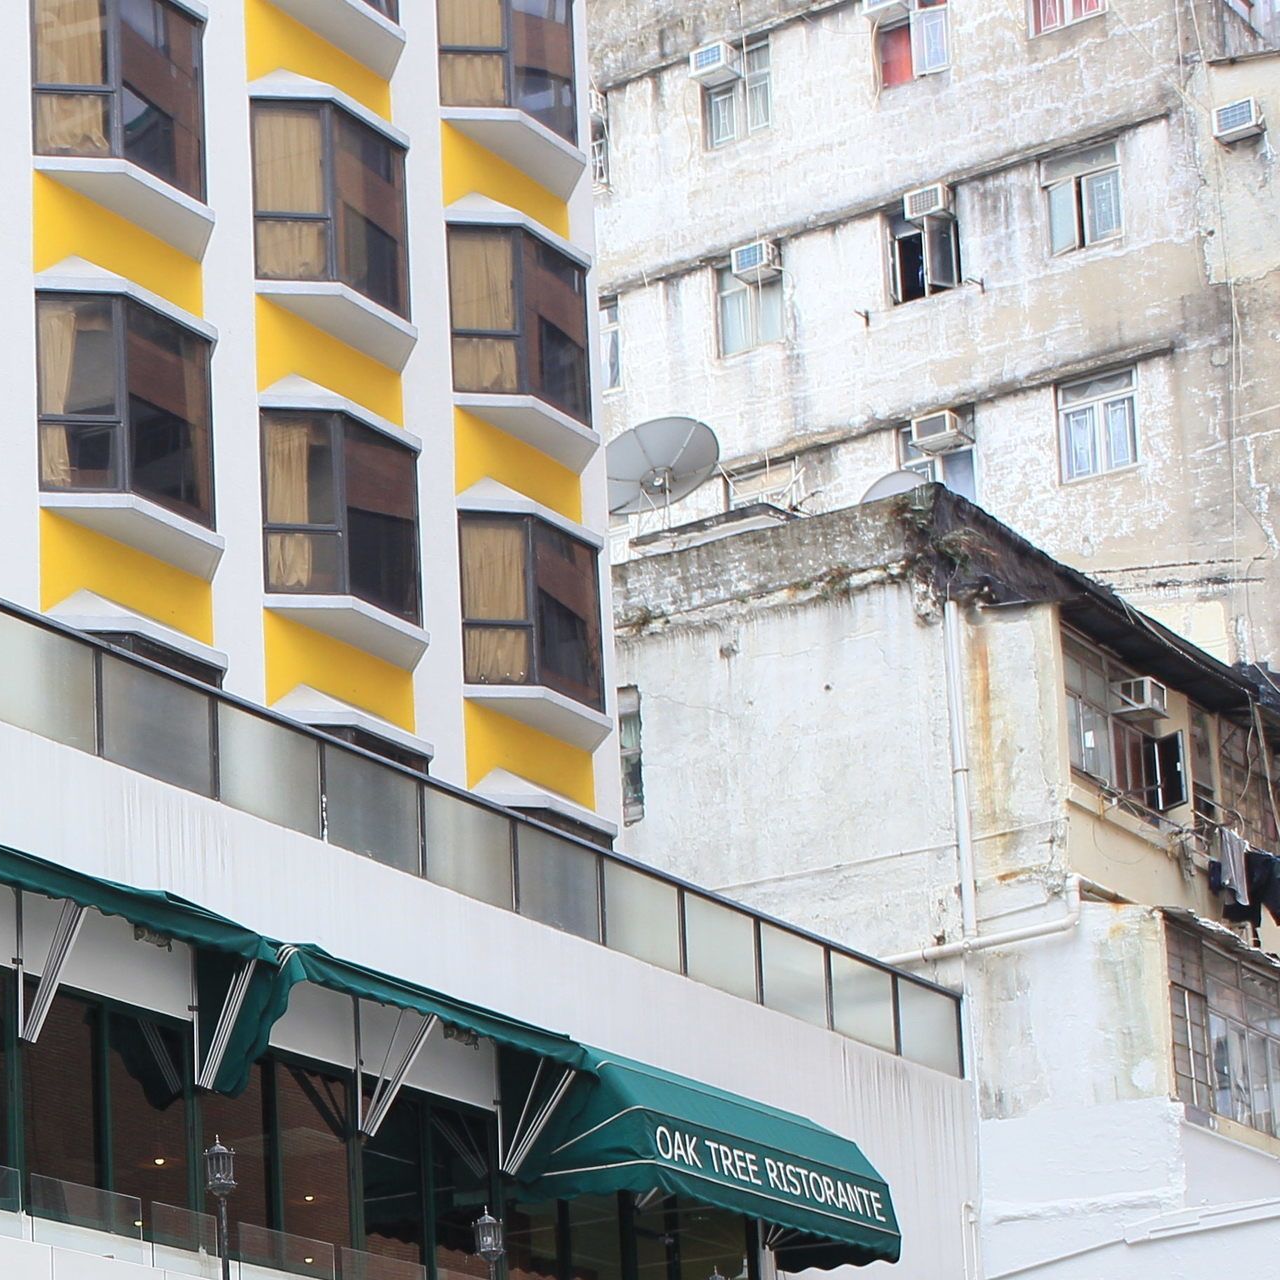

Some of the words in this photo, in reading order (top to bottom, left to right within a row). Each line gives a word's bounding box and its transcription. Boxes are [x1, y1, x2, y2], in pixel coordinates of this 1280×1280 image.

[655, 1125, 702, 1168] OAK
[704, 1140, 762, 1186] TREE
[764, 1156, 886, 1222] RISTORANTE
